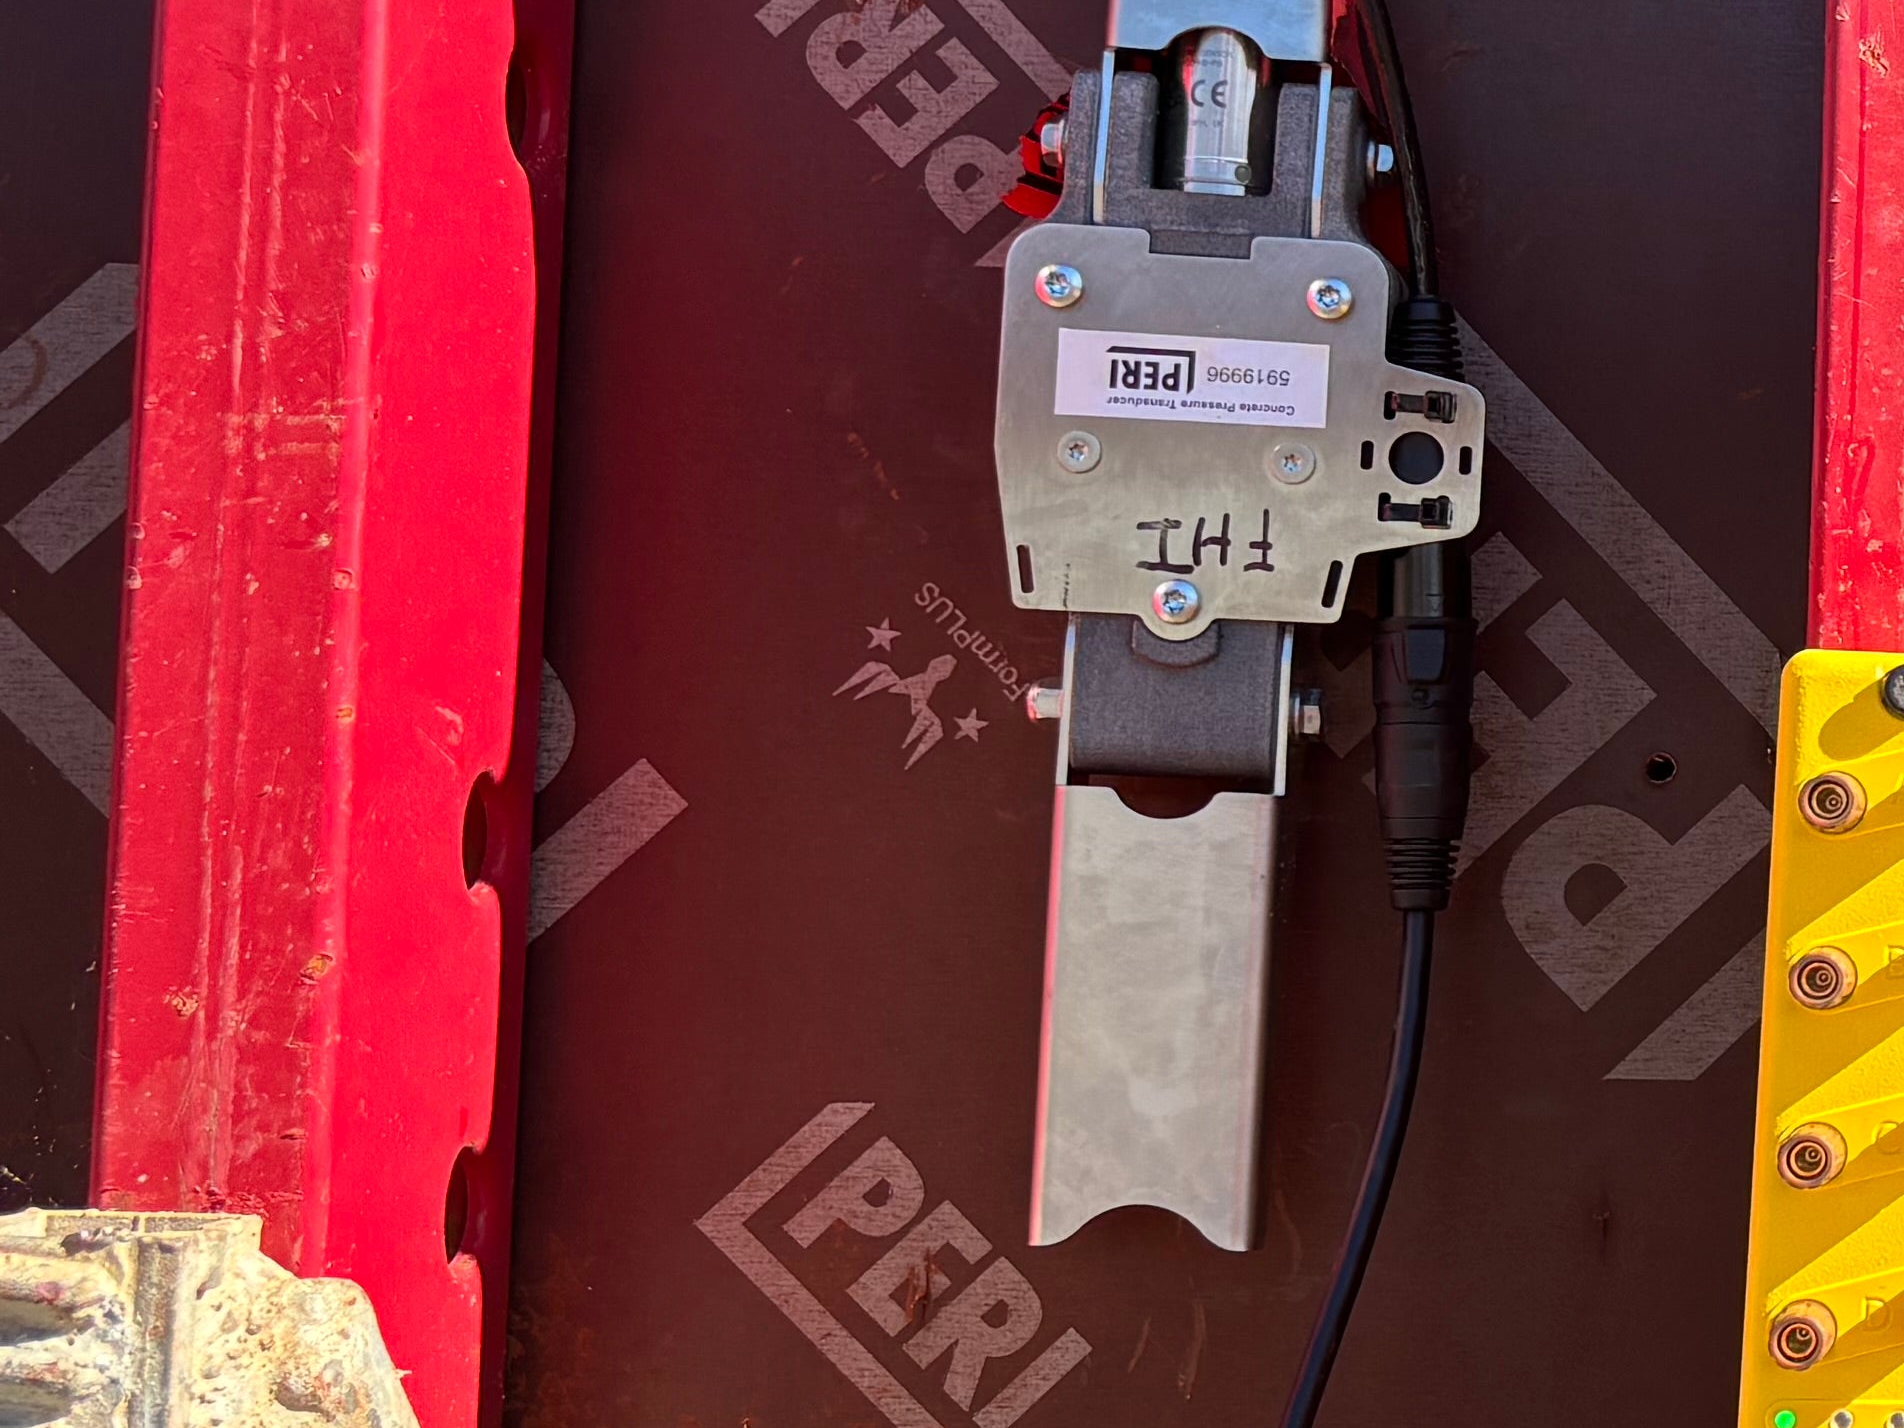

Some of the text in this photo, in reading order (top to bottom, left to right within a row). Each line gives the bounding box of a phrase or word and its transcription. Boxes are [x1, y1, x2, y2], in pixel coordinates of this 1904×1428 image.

[1190, 79, 1228, 108] CE
[1109, 359, 1180, 391] PERI
[1207, 366, 1289, 386] 5919996
[1107, 396, 1294, 415] Concrete Pressure Transducer
[914, 582, 1029, 701] FormPLUS
